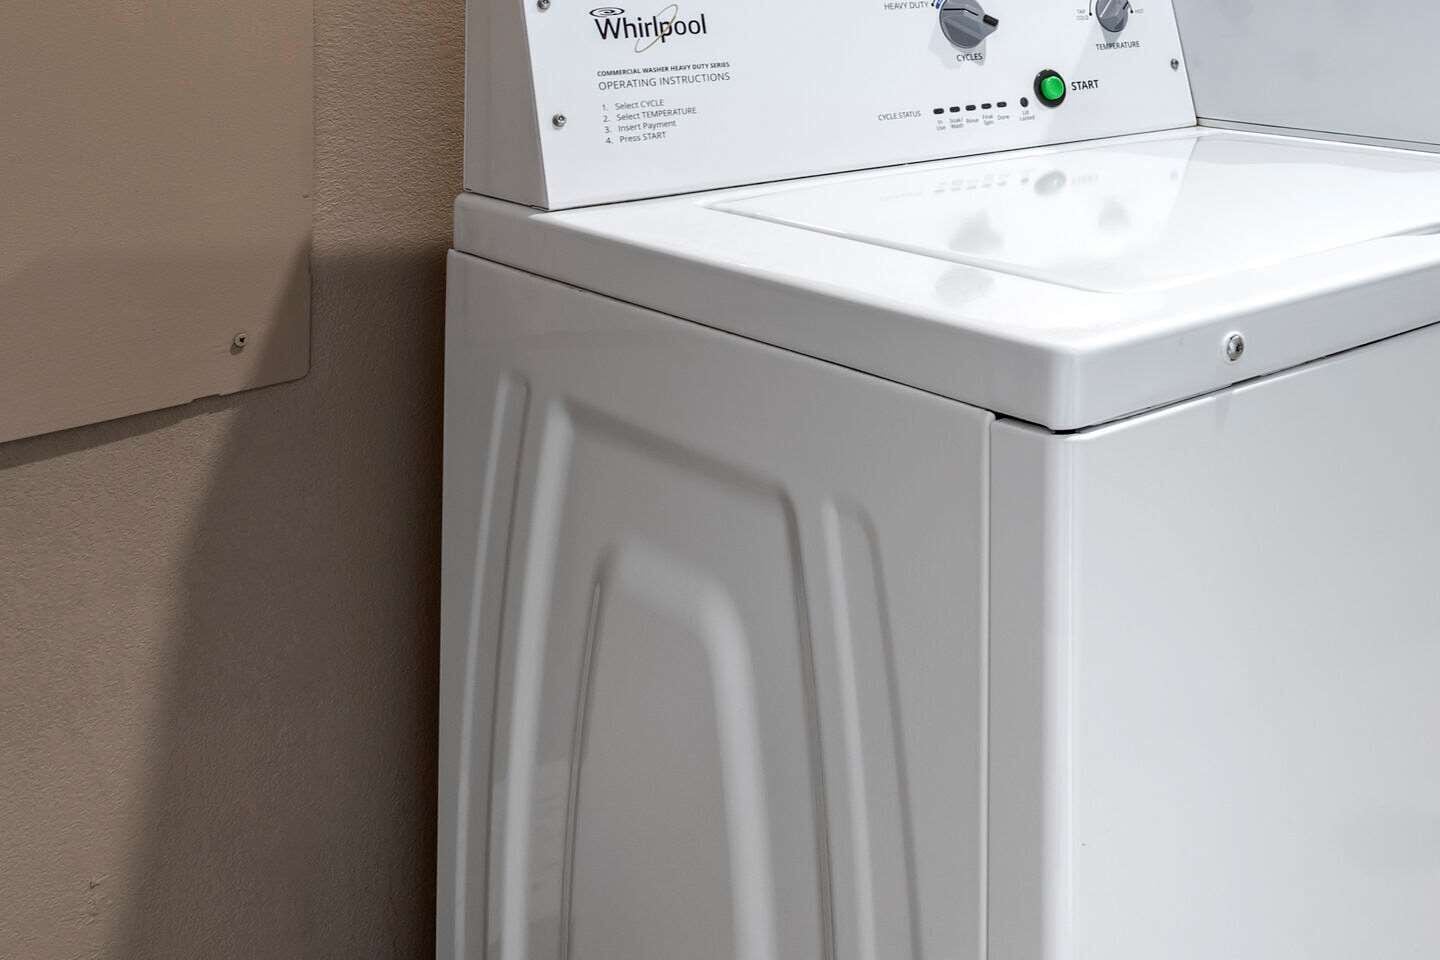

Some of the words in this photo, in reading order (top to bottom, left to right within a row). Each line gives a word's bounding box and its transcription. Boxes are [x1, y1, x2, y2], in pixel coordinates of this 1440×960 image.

[884, 1, 908, 10] HEAVY
[909, 0, 929, 9] DUTY
[594, 13, 707, 43] Whirlpool
[1096, 41, 1140, 51] TEMPERATURE
[956, 52, 983, 62] CYCLES
[597, 68, 641, 77] COMMERCIAL
[598, 77, 657, 91] OPERATING
[659, 72, 731, 86] INSTRUCTIONS
[1071, 79, 1099, 91] START
[615, 101, 639, 110] Select
[640, 99, 664, 108] CYCLE
[616, 112, 640, 121] Select
[641, 106, 697, 119] TEMPERATURE
[878, 112, 900, 121] CYCLE
[900, 110, 922, 119] STATUS
[618, 123, 641, 132] Insert
[642, 120, 677, 131] Payment
[619, 135, 641, 143] Press
[642, 131, 666, 141] START
